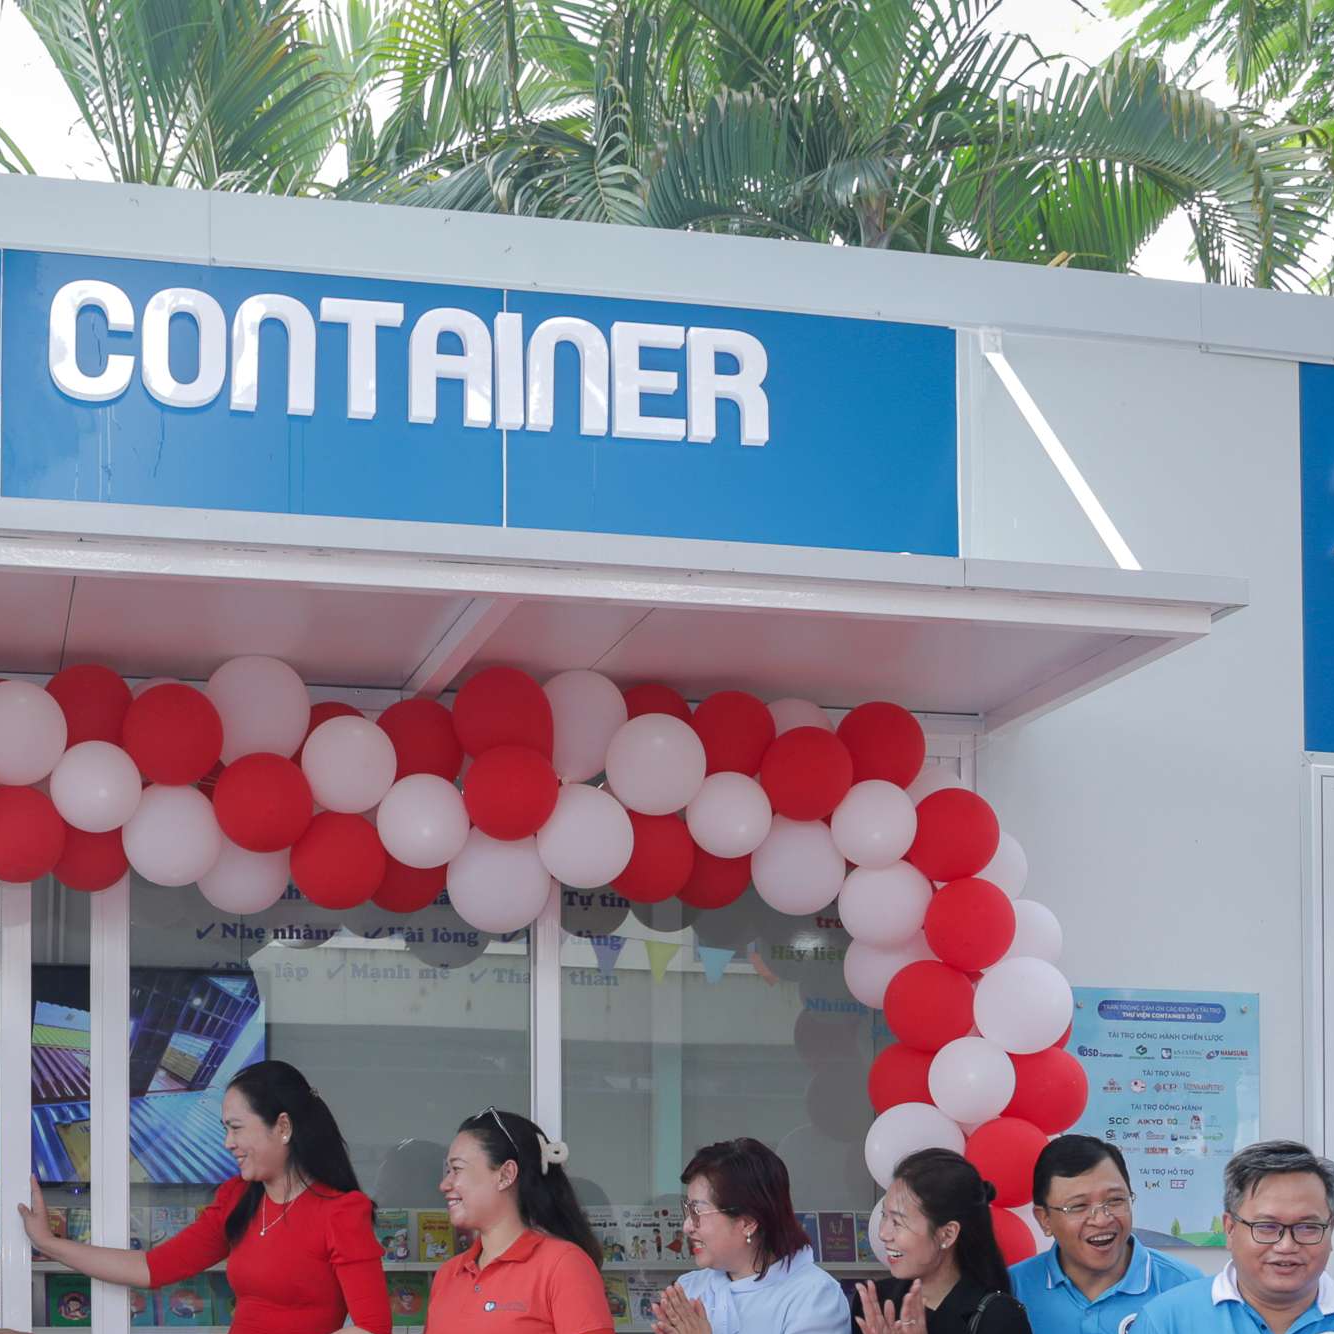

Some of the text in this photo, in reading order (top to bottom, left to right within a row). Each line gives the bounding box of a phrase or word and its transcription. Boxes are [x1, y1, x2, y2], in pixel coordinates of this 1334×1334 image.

[50, 278, 770, 447] CONTAINER
[221, 923, 266, 942] Nhẹ
[432, 928, 479, 947] lòng
[351, 964, 411, 982] Mạnh
